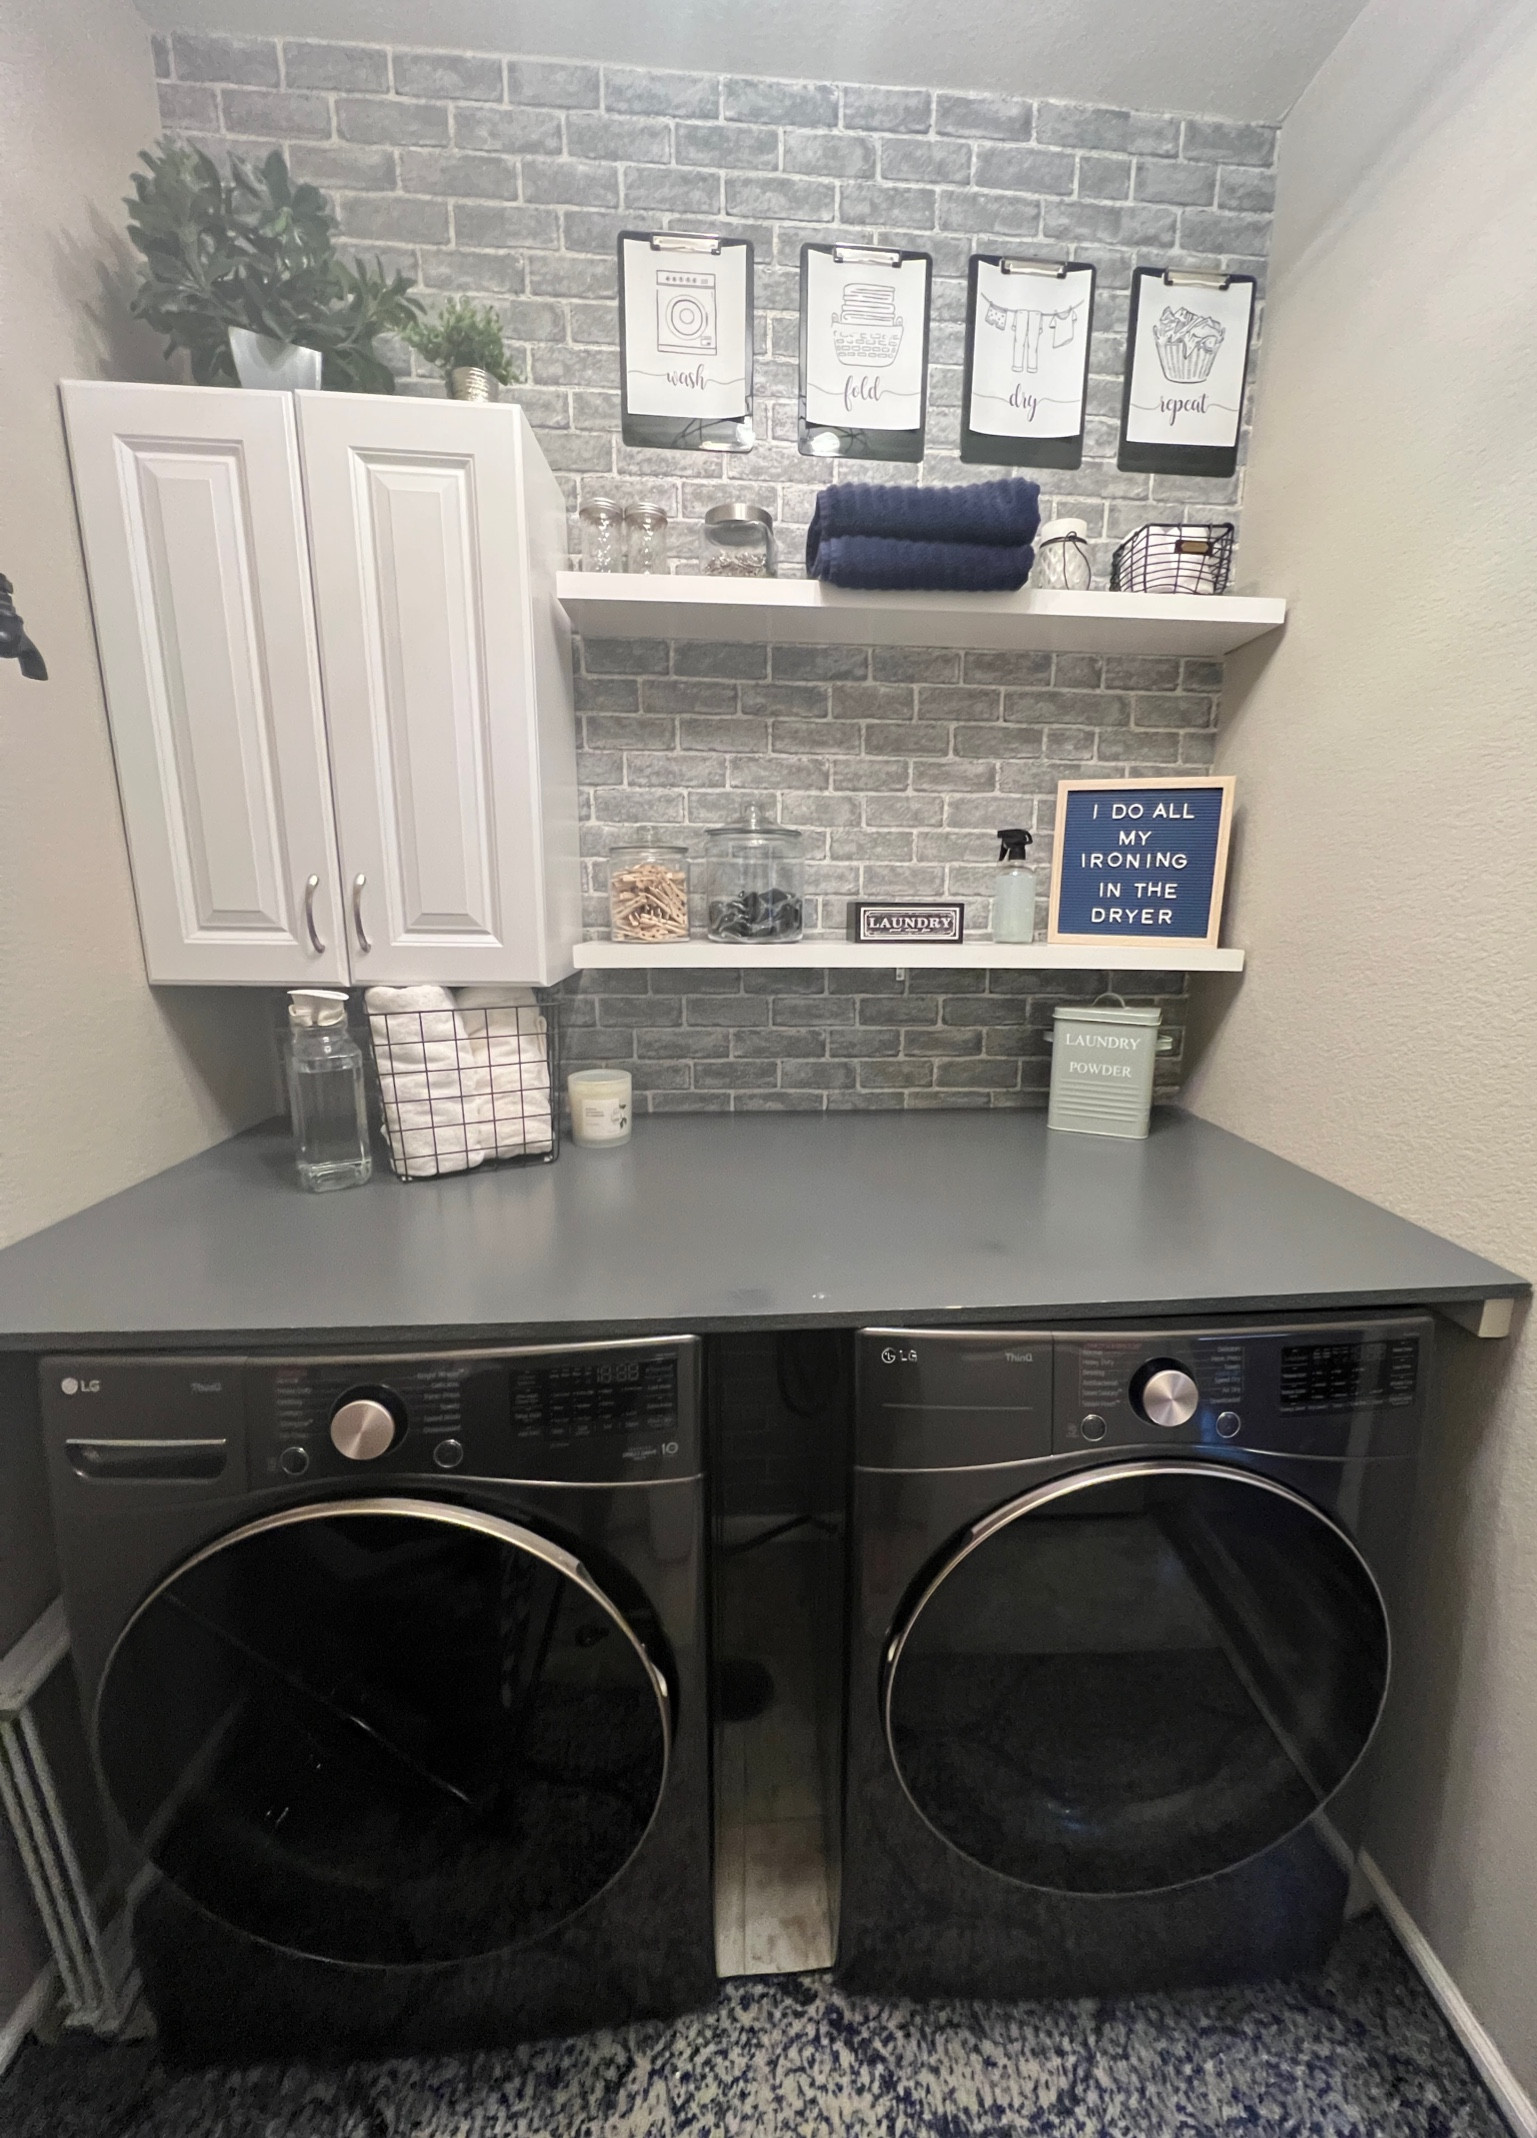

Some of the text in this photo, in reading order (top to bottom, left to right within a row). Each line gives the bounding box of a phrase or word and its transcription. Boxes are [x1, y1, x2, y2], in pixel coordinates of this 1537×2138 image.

[666, 363, 706, 390] wash
[844, 375, 882, 412] fold
[1009, 383, 1037, 422] dry
[1159, 393, 1208, 426] repeat
[1092, 802, 1195, 820] I DO ALL
[1118, 830, 1152, 846] MY
[1081, 852, 1188, 869] IRONING
[1099, 882, 1178, 899] IN THE
[868, 917, 951, 928] LAUNDRY
[1091, 907, 1173, 925] DRYER
[1065, 1033, 1141, 1050] LAUNDRY
[1069, 1061, 1132, 1078] POWDER
[899, 1349, 918, 1362] LG
[80, 1379, 100, 1392] LG
